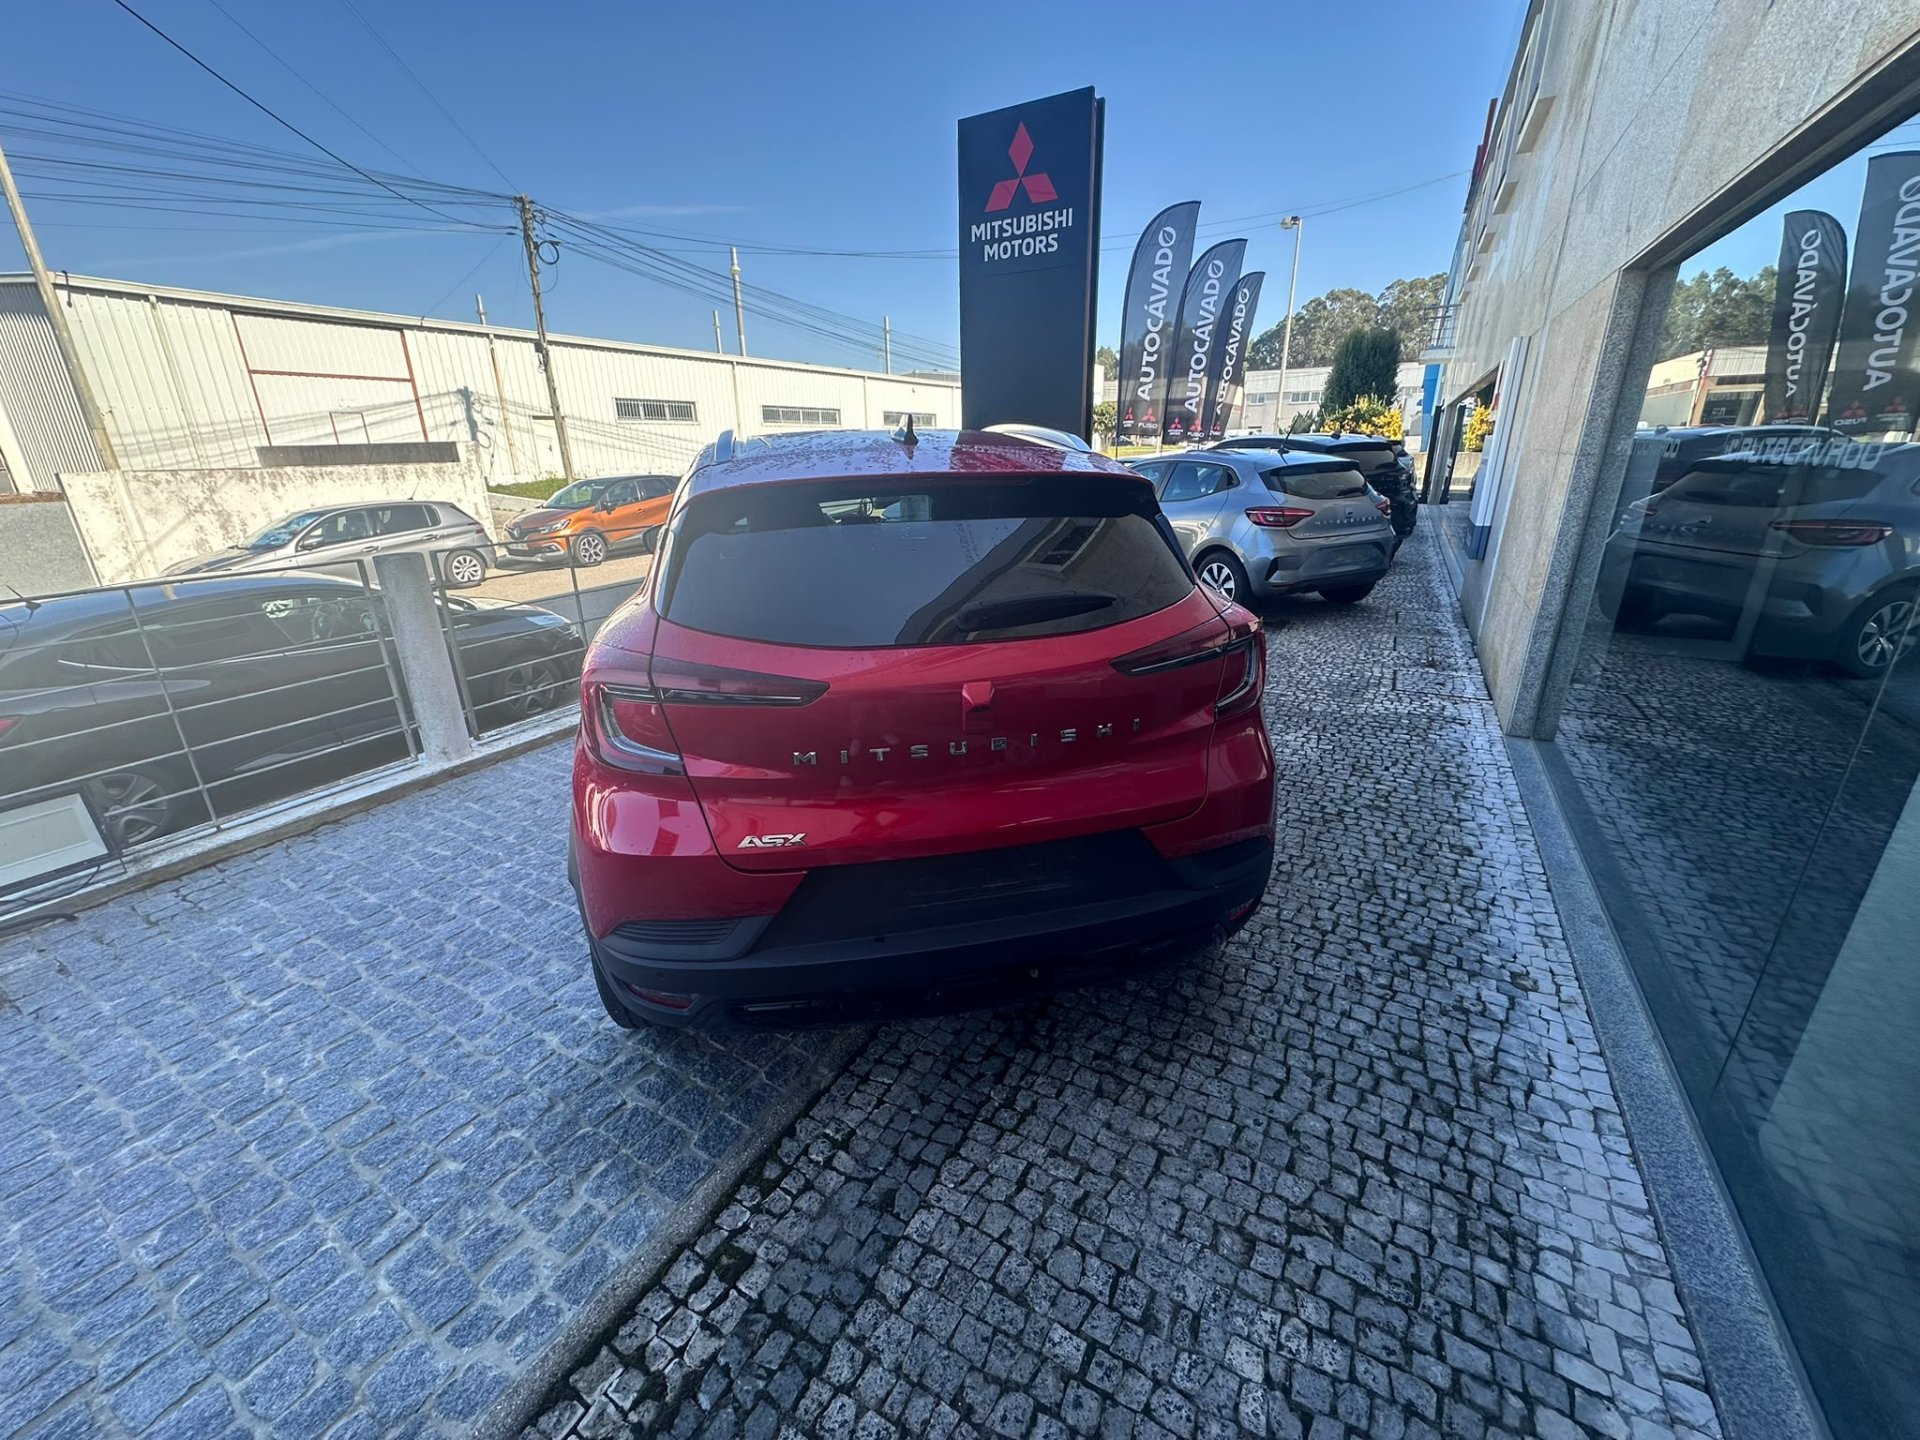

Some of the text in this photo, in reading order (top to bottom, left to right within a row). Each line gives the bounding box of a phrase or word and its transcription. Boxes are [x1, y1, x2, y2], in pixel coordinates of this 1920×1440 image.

[971, 208, 1073, 242] MITSUBISHI
[984, 234, 1059, 262] MOTORS
[1138, 422, 1158, 430] FUSO
[793, 718, 1141, 766] MITSUBISHI
[737, 832, 806, 848] ASX
